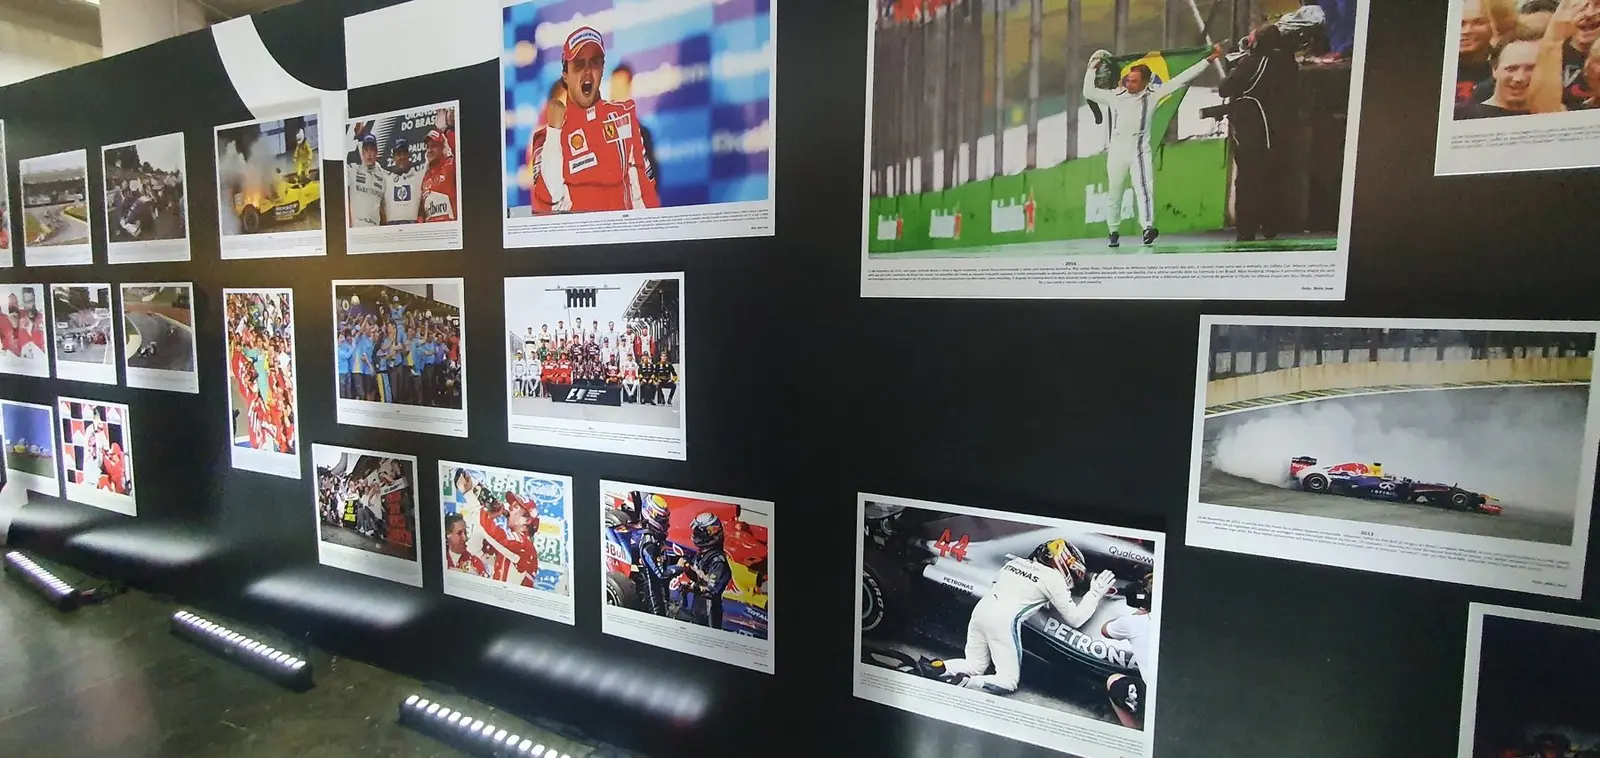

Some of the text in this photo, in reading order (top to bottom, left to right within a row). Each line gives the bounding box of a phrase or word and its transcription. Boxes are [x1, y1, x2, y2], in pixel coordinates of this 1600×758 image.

[401, 120, 413, 131] DO
[935, 528, 970, 562] 44
[1004, 564, 1040, 583] ETRONAS
[943, 576, 974, 591] PETRONAS
[746, 606, 768, 621] TOTAL
[1043, 617, 1140, 669] PETRONA
